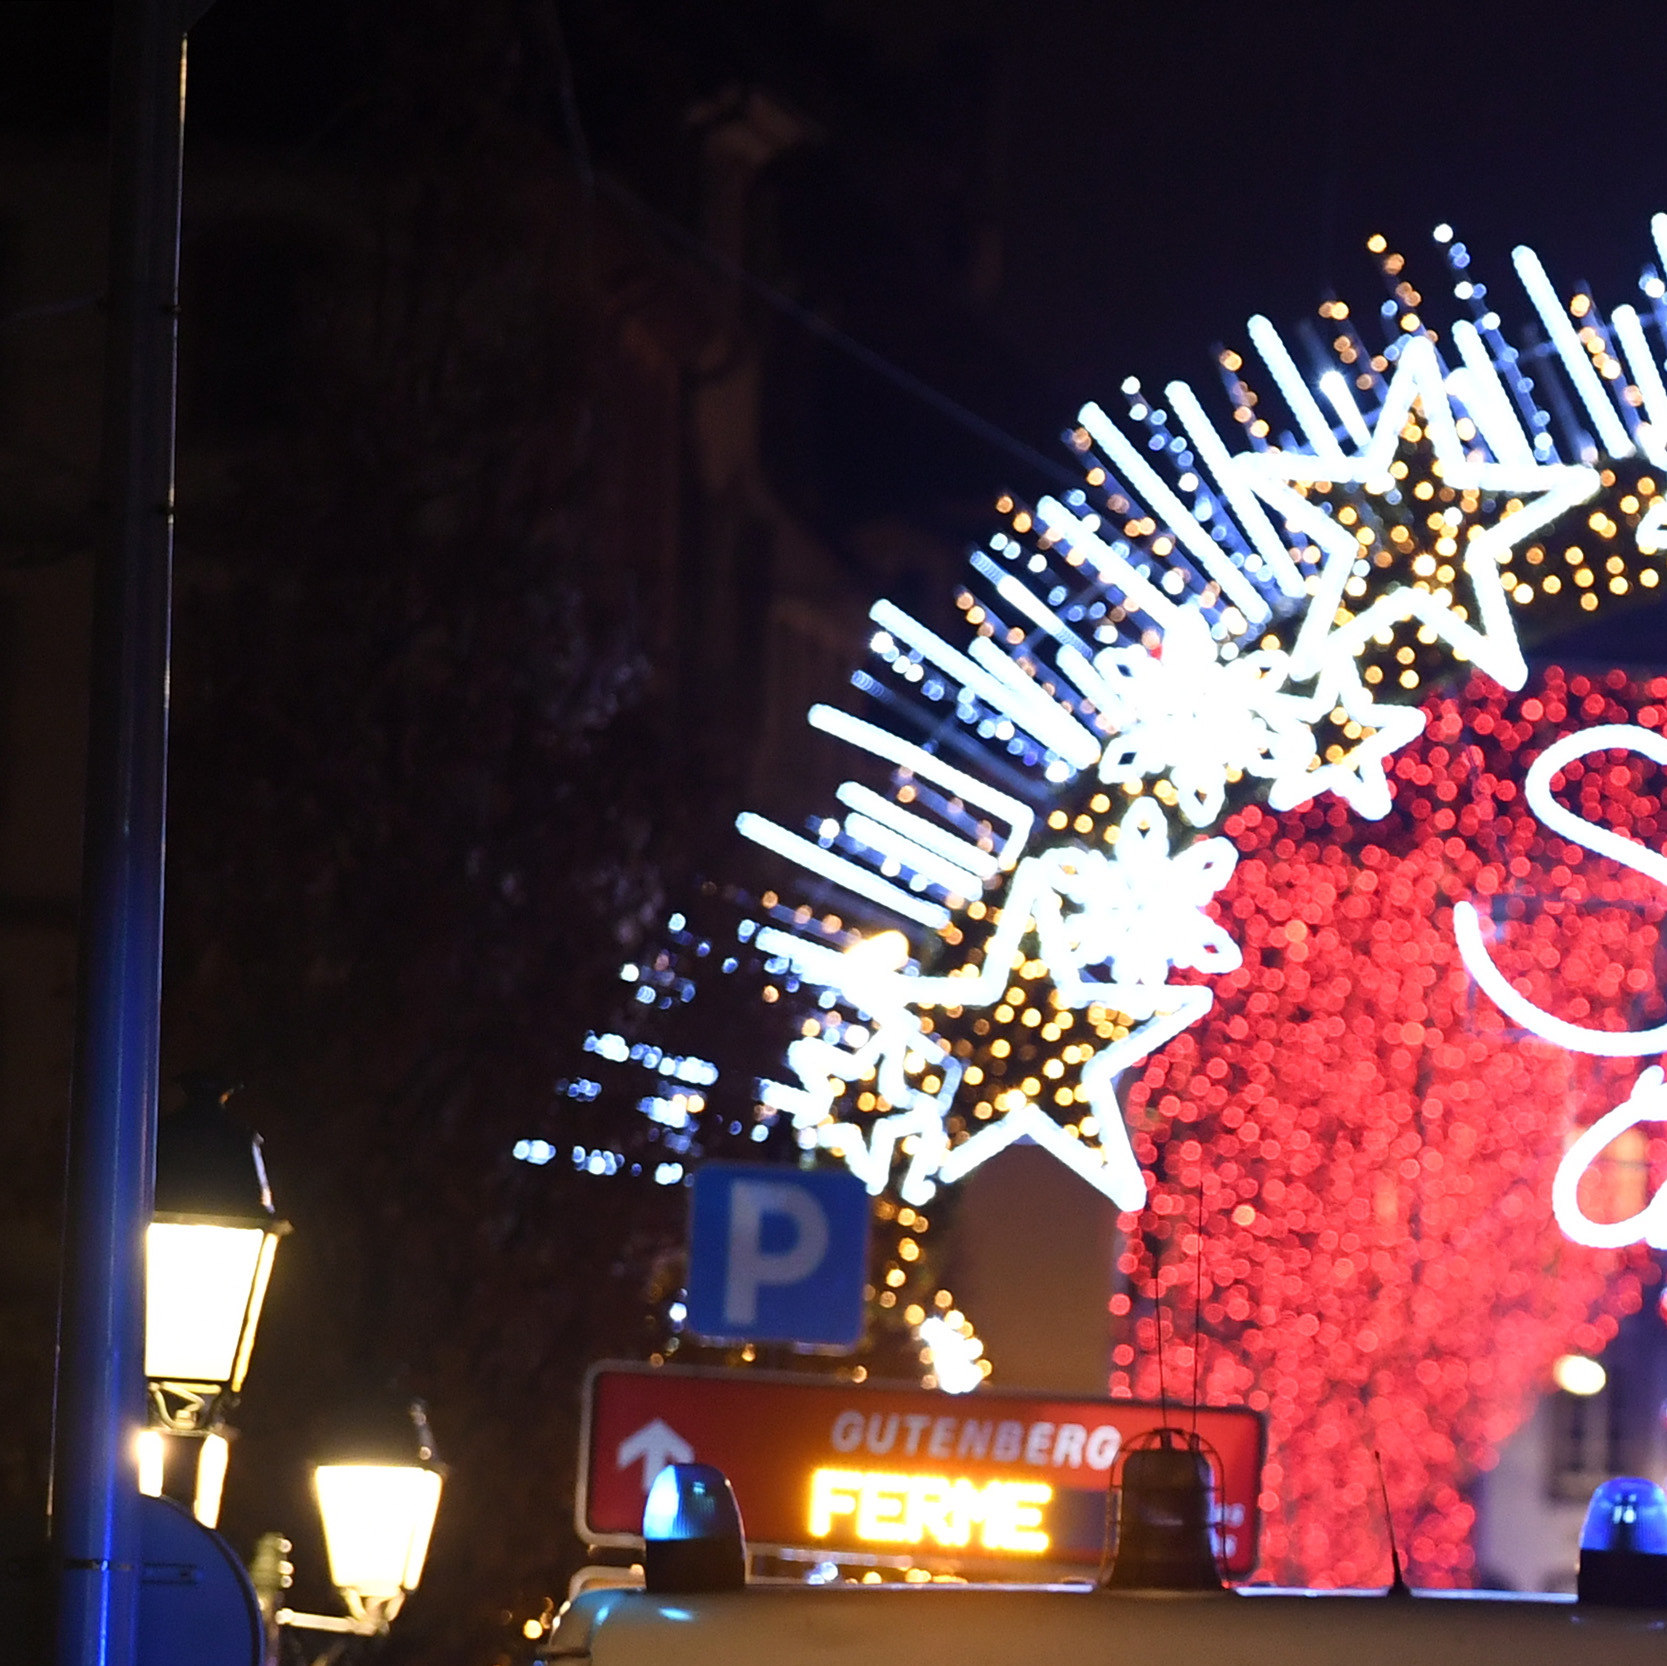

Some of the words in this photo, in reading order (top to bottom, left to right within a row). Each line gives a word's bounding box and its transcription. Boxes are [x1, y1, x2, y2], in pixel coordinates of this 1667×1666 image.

[723, 1179, 829, 1326] P
[830, 1409, 1122, 1471] GUTENBERG
[808, 1467, 1053, 1552] FERME
